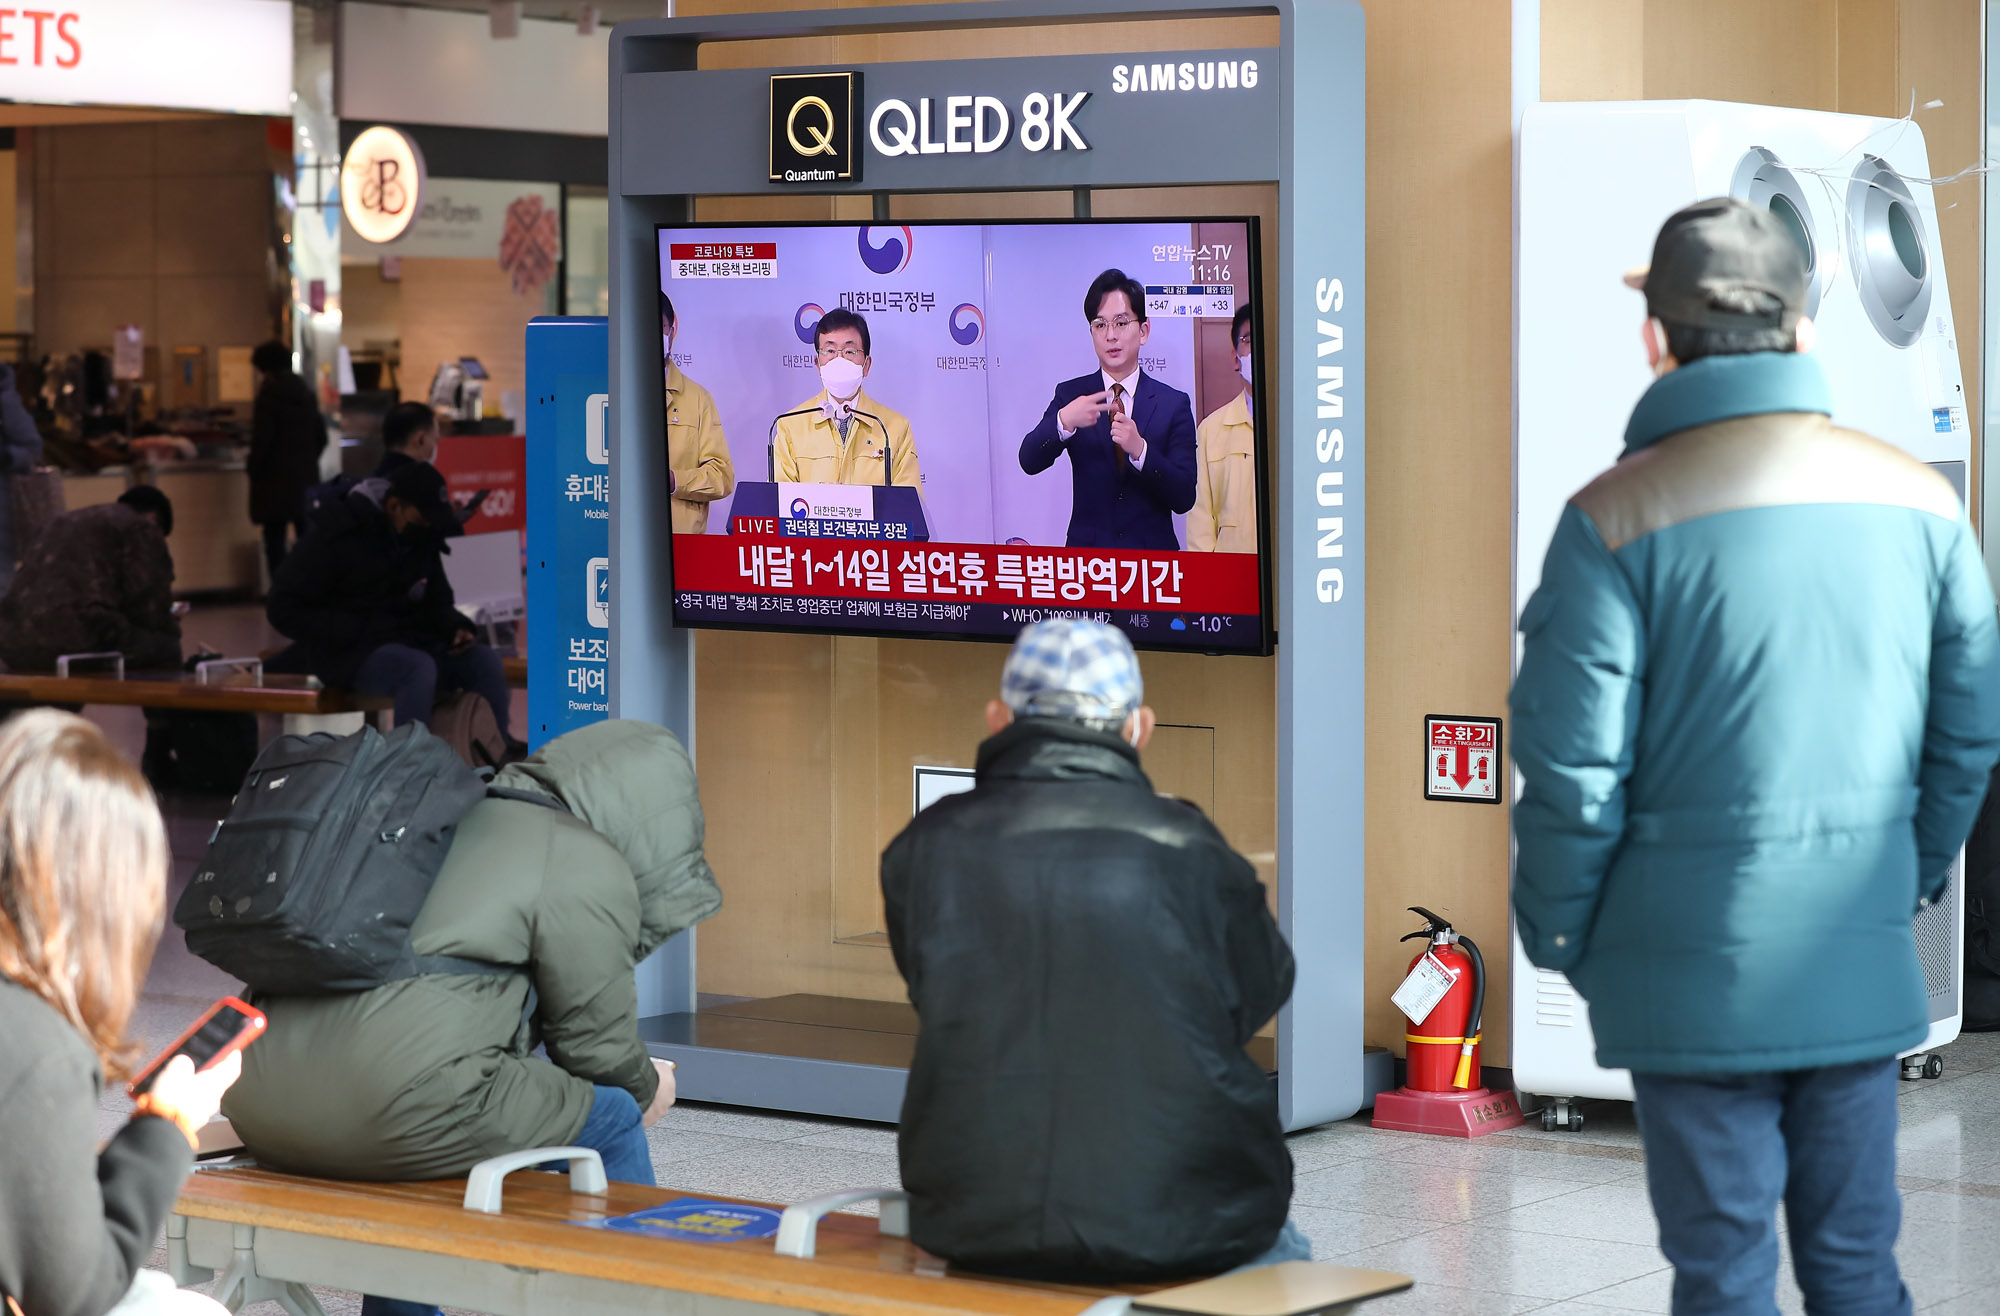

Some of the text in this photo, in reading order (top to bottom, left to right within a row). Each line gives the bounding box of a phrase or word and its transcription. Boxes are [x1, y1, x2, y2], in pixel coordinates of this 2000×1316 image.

[1112, 60, 1258, 93] SAMSUNG
[786, 95, 838, 157] Q
[869, 91, 1090, 157] QLED 8K
[785, 169, 835, 181] Quantum
[694, 245, 755, 258] 코로나19 특보
[1152, 244, 1233, 262] 연합뉴스TV
[679, 262, 771, 277] 중대본, 대응책 브리핑
[1189, 265, 1231, 281] 11:16
[1162, 286, 1175, 295] 국내
[1219, 286, 1232, 295] 유입
[839, 291, 936, 313] 대한민국정부
[1149, 300, 1169, 311] +547
[1173, 305, 1203, 315] 서울 148
[1211, 300, 1229, 311] +33
[1315, 277, 1344, 604] SAMSUNG
[584, 509, 608, 519] Mobile
[813, 505, 862, 518] 대한민국정부
[739, 518, 774, 534] LIVE
[785, 520, 908, 540] 권덕철 보건복지부 장관
[738, 545, 1184, 604] 내달 1~14일 설연휴 특별방역기간
[680, 593, 703, 609] 영국
[705, 594, 727, 610] 대법
[760, 597, 794, 613] 조치로
[846, 600, 880, 617] 업체에
[883, 602, 918, 619] 보험금
[921, 603, 971, 621] 지급해야"
[1011, 608, 1042, 623] WHO
[1129, 613, 1150, 628] 세종
[568, 638, 608, 662] 보조
[568, 667, 605, 695] 대여
[568, 700, 592, 711] Power
[1434, 725, 1492, 742] 소화기
